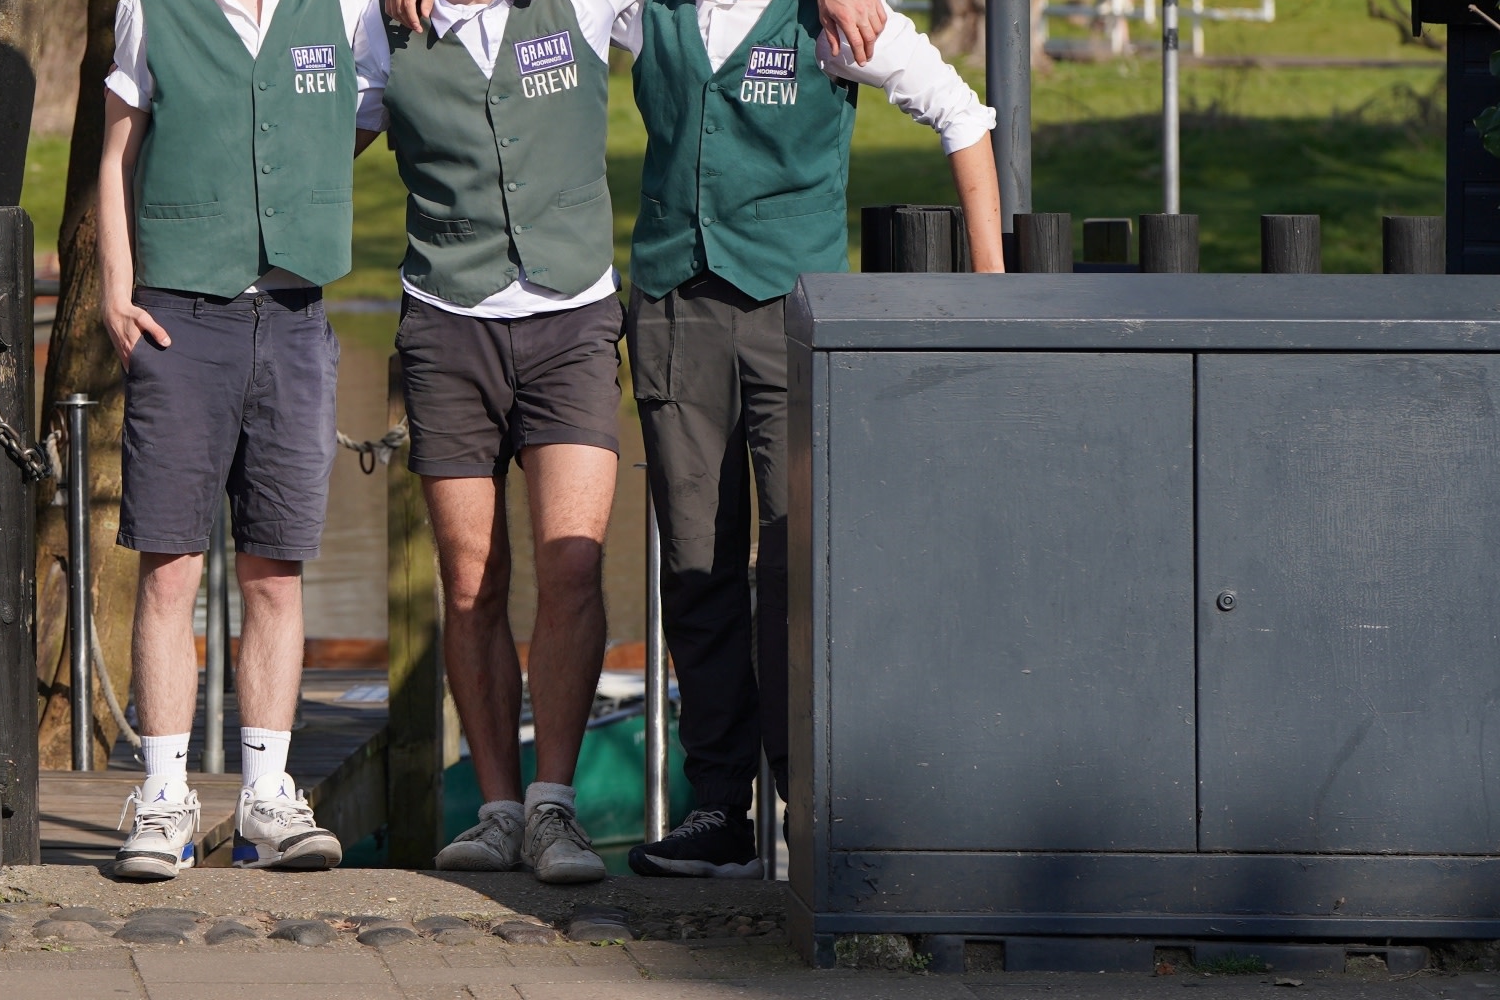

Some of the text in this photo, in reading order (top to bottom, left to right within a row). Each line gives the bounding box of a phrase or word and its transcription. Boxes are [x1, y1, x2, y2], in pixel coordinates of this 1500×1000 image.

[294, 47, 334, 67] GRANTA
[520, 36, 568, 66] GRANTA
[750, 50, 795, 73] GRANTA
[295, 72, 336, 94] CREW
[521, 64, 578, 98] CREW
[756, 68, 788, 76] MOORINGS
[740, 80, 798, 105] CREW
